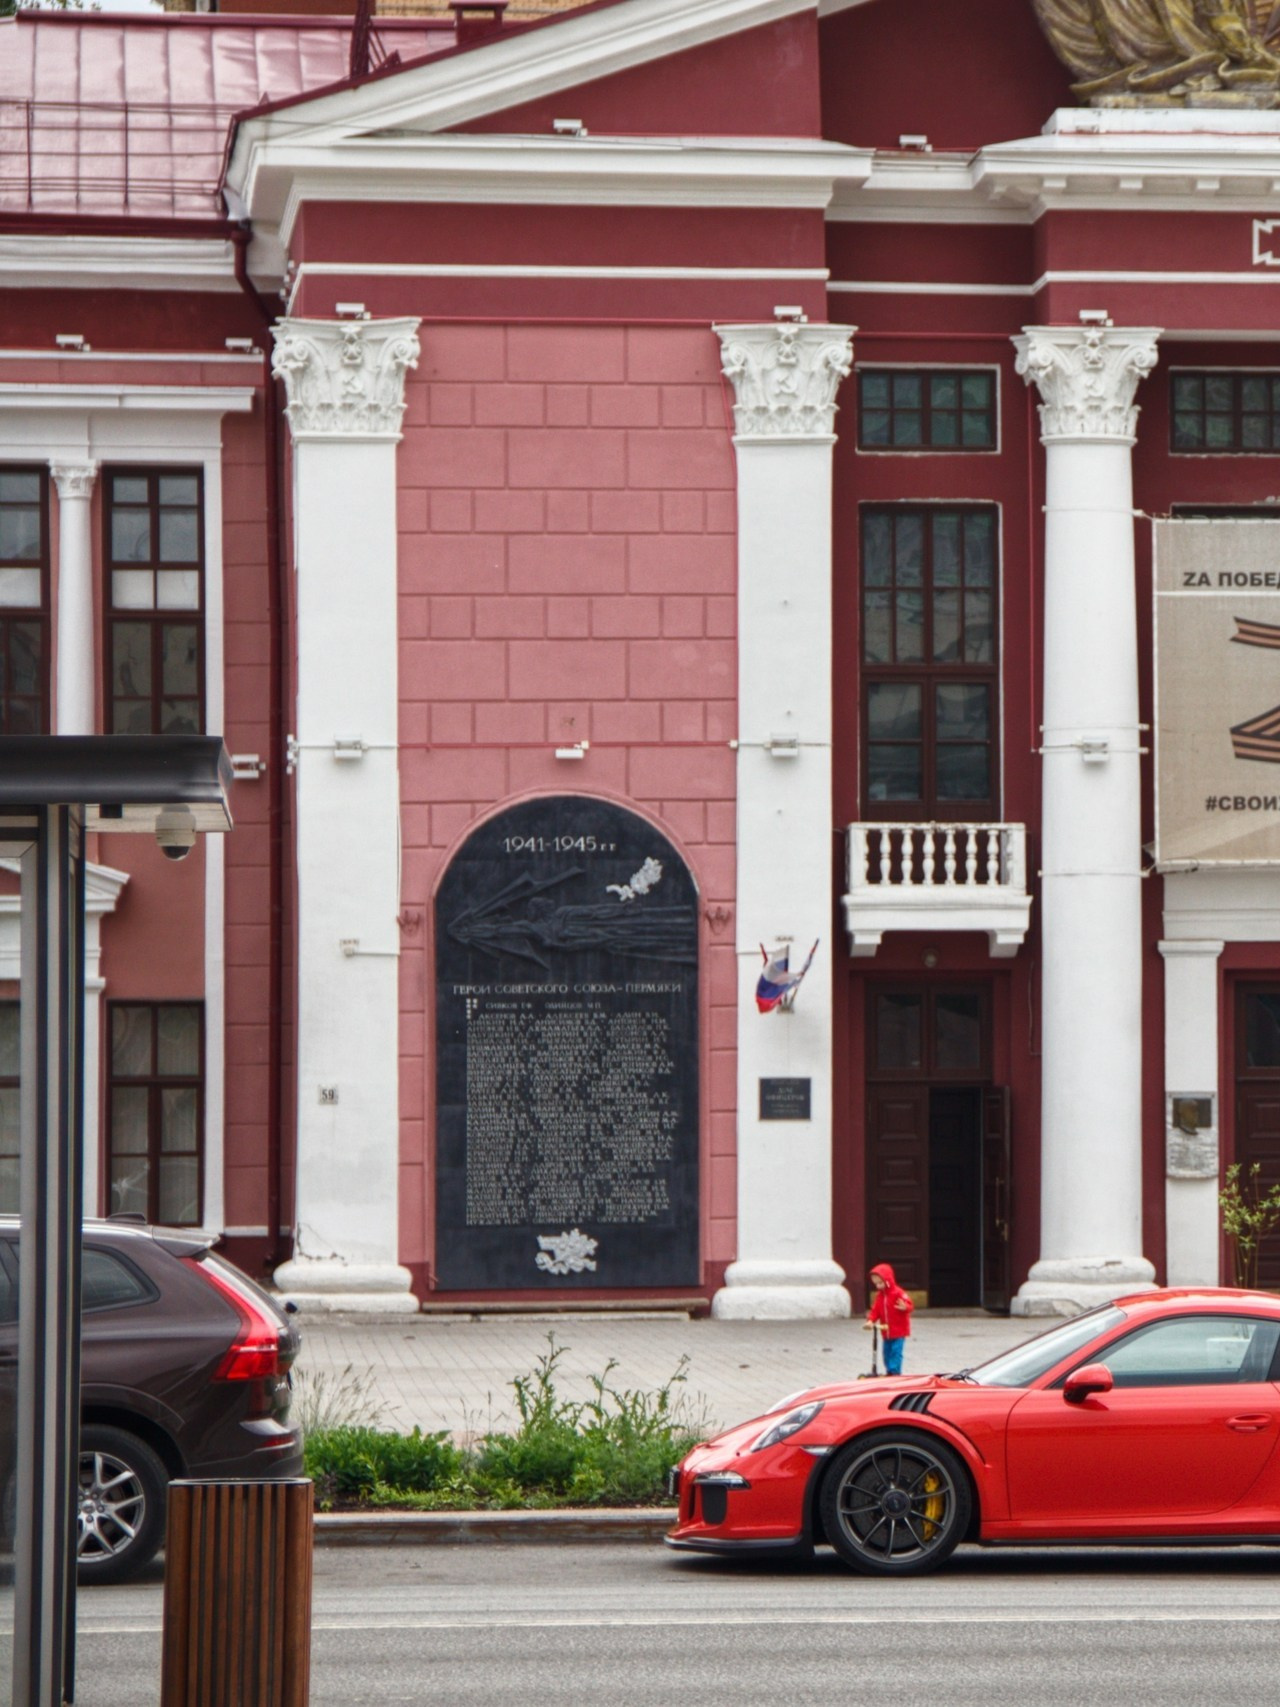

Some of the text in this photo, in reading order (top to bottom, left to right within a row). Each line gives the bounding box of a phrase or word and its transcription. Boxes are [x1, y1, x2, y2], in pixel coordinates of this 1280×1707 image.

[453, 984, 491, 995] ГЕРОИ
[494, 983, 568, 994] СОВЕТСКОГО
[321, 1089, 335, 1101] 59
